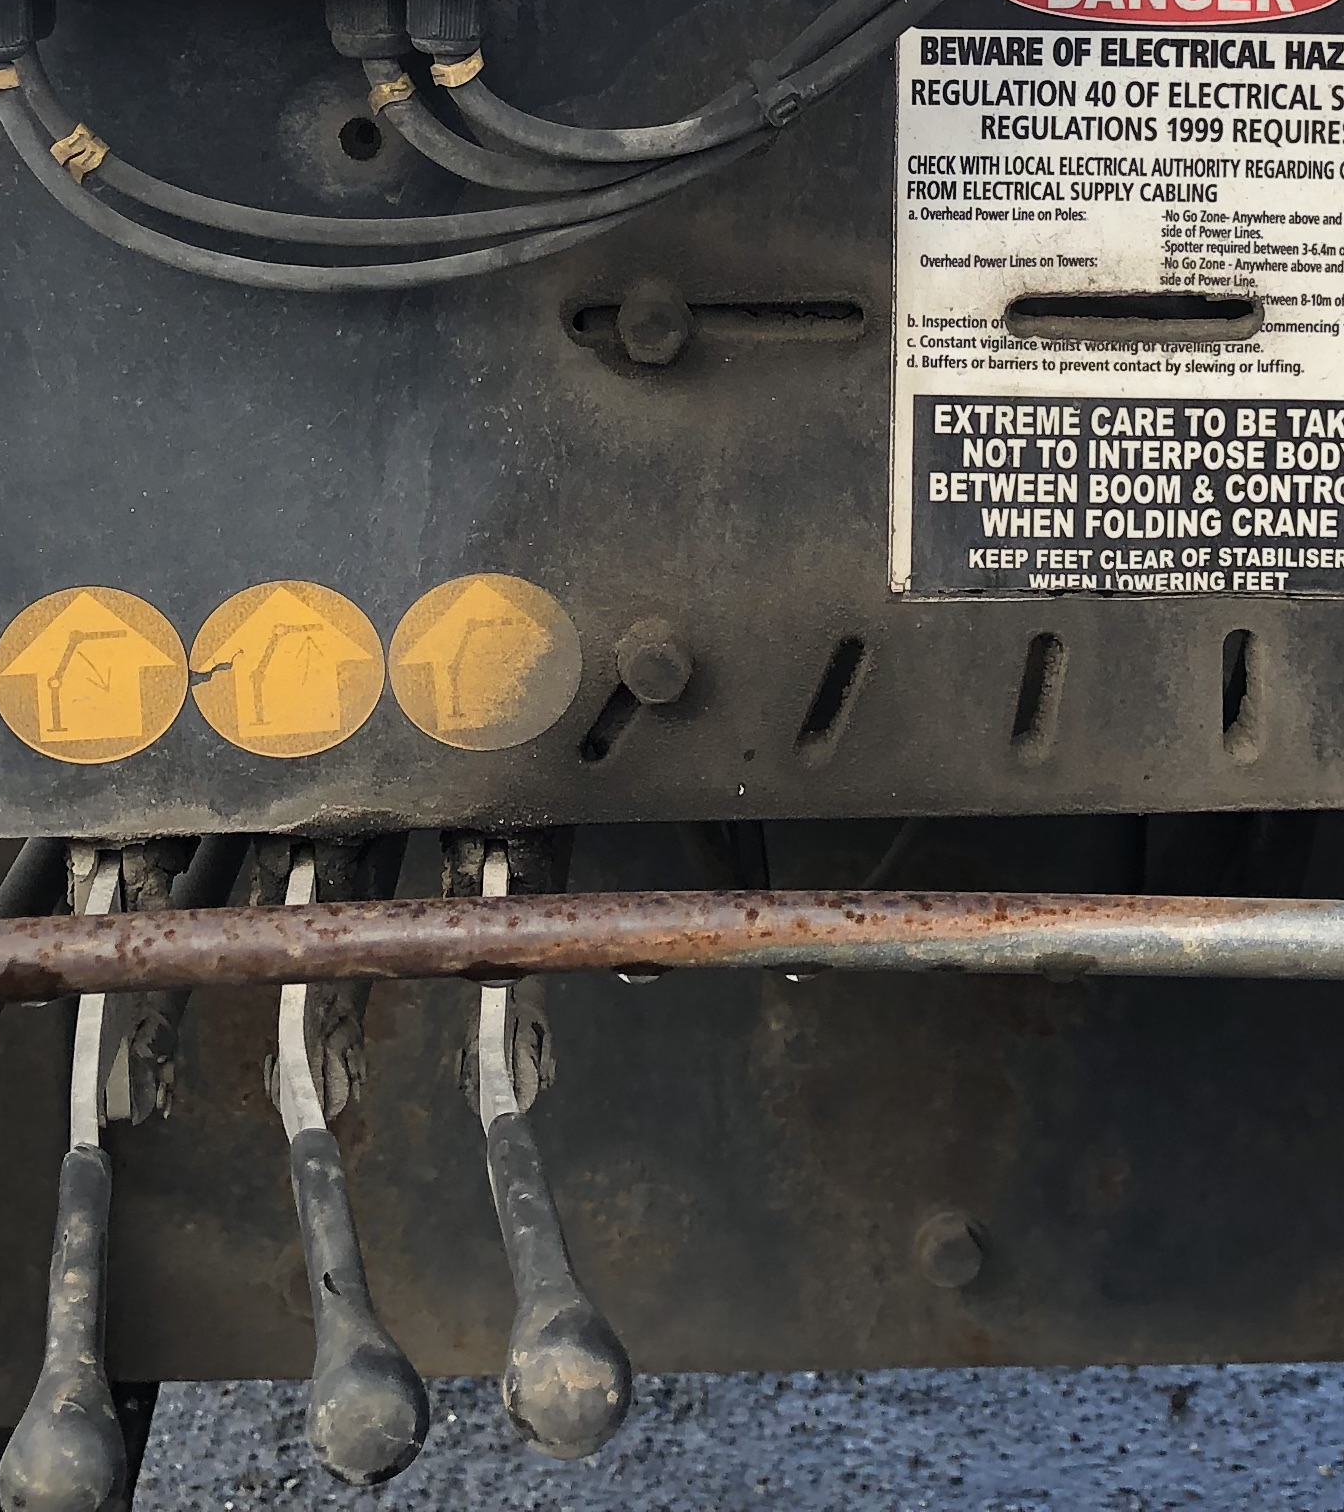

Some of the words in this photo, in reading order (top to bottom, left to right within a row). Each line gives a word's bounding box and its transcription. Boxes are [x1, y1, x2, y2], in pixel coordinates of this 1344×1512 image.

[920, 35, 1043, 66] BEWARE
[1051, 36, 1091, 67] OF
[1099, 37, 1275, 69] ELECTRICAL
[910, 78, 1076, 107] REGULATION
[1084, 80, 1116, 107] 40
[1124, 80, 1159, 108] OF
[1168, 81, 1322, 111] ELECTRICAL
[980, 114, 1158, 142] REGULATIONS
[1166, 116, 1223, 143] 1999
[907, 155, 956, 175] CHECK
[959, 155, 1000, 175] WITH
[1004, 156, 1055, 176] LOCAL
[1058, 156, 1147, 177] ELECTRICAL
[1150, 157, 1241, 178] AUTHORITY
[1244, 158, 1334, 180] REGARDING
[906, 180, 957, 200] FROM
[962, 181, 1065, 201] ELECTRICAL
[1069, 182, 1134, 202] SUPPLY
[1139, 182, 1217, 203] CABLING
[907, 209, 918, 220] a.
[919, 206, 973, 221] Overhead
[974, 206, 1010, 221] Power
[1011, 206, 1035, 221] Line
[1036, 209, 1052, 221] on
[1054, 207, 1086, 221] Poles:
[1182, 209, 1198, 223] Go
[1231, 209, 1286, 226] Anywhere
[1287, 210, 1320, 225] above
[1321, 211, 1342, 225] and
[1160, 225, 1182, 238] side
[1184, 226, 1196, 238] of
[1198, 226, 1232, 239] Power
[1233, 226, 1263, 239] Lines.
[919, 253, 971, 268] Overhead
[973, 254, 1007, 268] Power
[1009, 253, 1037, 268] Lines
[1038, 256, 1054, 268] on
[1055, 254, 1098, 268] Towers:
[1205, 241, 1251, 257] required
[1252, 241, 1299, 256] between
[1301, 242, 1336, 256] 3-6.4m
[1181, 256, 1197, 270] Go
[1198, 256, 1226, 270] Zone
[1233, 257, 1288, 273] Anywhere
[1289, 258, 1322, 273] above
[1323, 259, 1344, 273] and
[1259, 319, 1340, 337] commencing
[905, 353, 918, 368] d.
[921, 354, 968, 369] Buffers
[970, 358, 985, 369] or
[987, 354, 1038, 371] barriers
[1041, 357, 1056, 371] to
[1058, 358, 1110, 375] prevent
[1112, 359, 1162, 372] contact
[1164, 358, 1181, 376] by
[1184, 358, 1235, 377] slewing
[1238, 362, 1254, 373] or
[1256, 358, 1304, 377] luffing.
[934, 403, 1080, 435] EXTREME
[1090, 406, 1174, 436] CARE
[1183, 407, 1226, 438] TO
[1236, 407, 1276, 437] BE
[962, 437, 1027, 468] NOT
[1035, 438, 1077, 469] TO
[1088, 439, 1265, 470] INTERPOSE
[929, 471, 1077, 503] BETWEEN
[1088, 473, 1180, 504] BOOM
[1191, 474, 1214, 504] &
[980, 507, 1074, 538] WHEN
[1084, 507, 1221, 539] FOLDING
[1231, 507, 1338, 537] CRANE
[968, 548, 1028, 568] KEEP
[1035, 548, 1093, 569] FEET
[1099, 548, 1175, 569] CLEAR
[1180, 548, 1212, 569] OF
[1233, 572, 1290, 591] FEET
